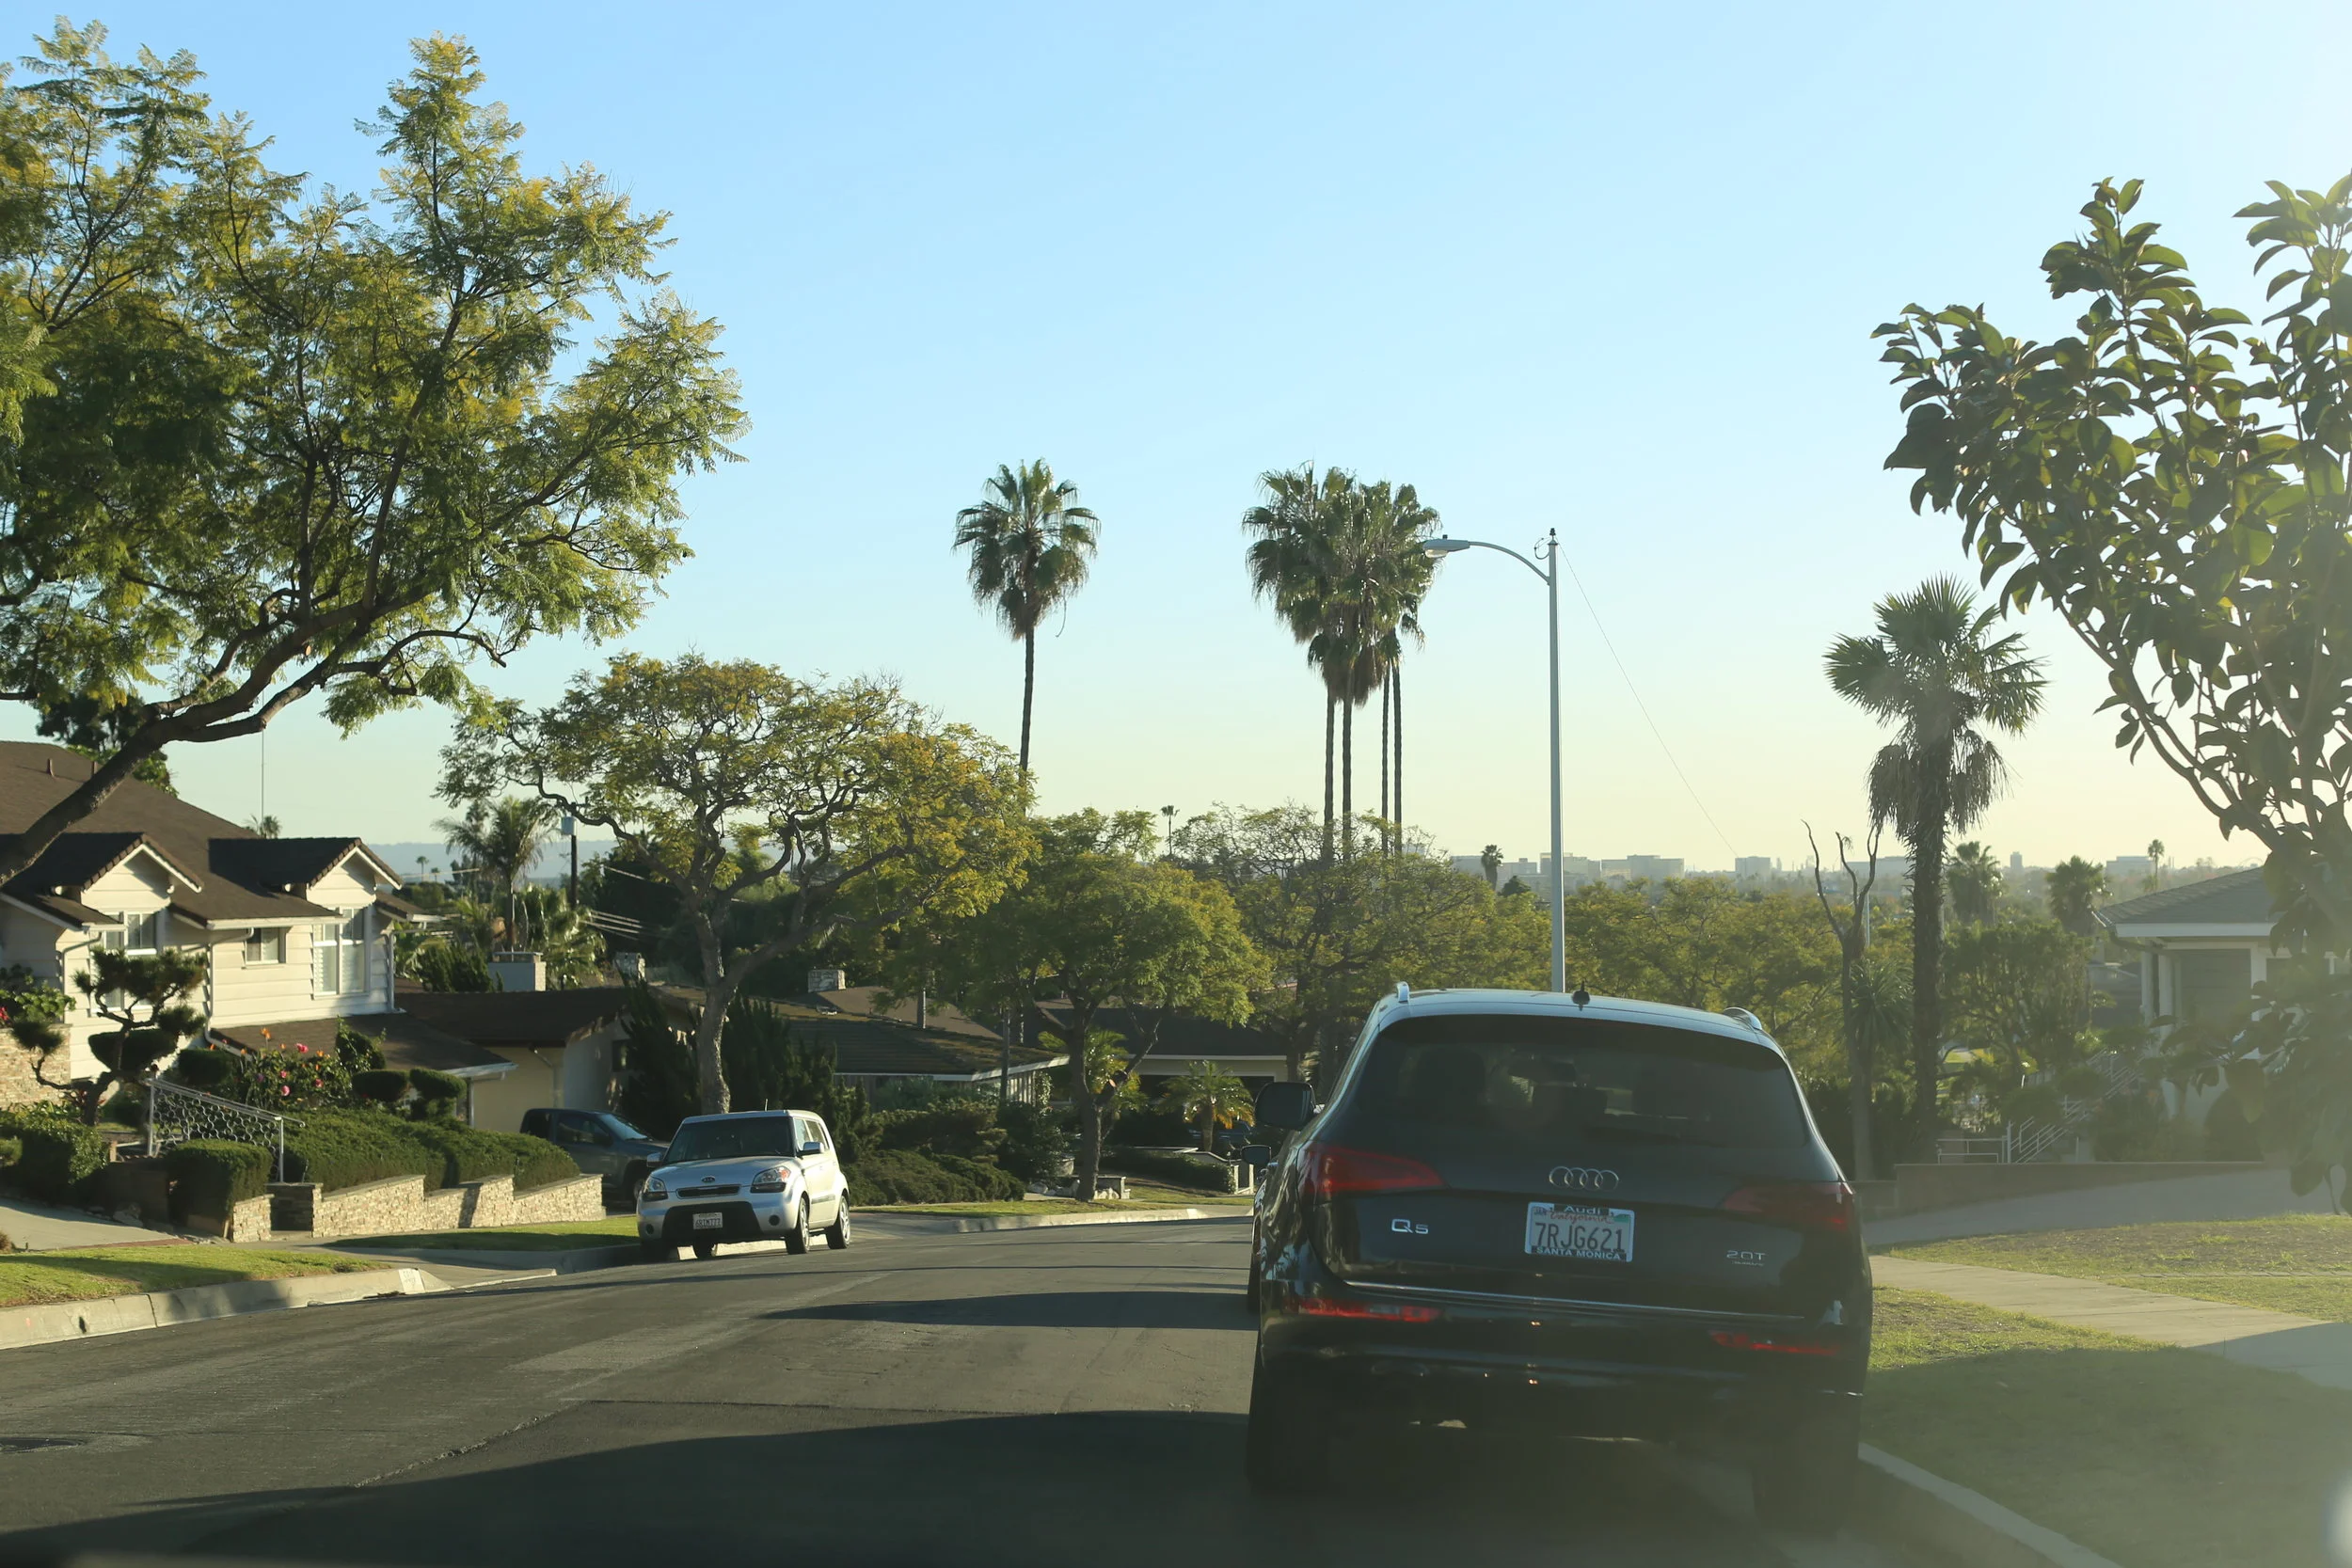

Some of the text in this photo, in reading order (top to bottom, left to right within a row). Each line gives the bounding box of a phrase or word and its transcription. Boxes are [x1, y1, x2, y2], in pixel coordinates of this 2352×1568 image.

[1564, 1205, 1601, 1215] Audi
[1391, 1218, 1429, 1234] Q5
[1535, 1223, 1624, 1252] 7RJG621
[1536, 1247, 1620, 1259] SANTA MONICA
